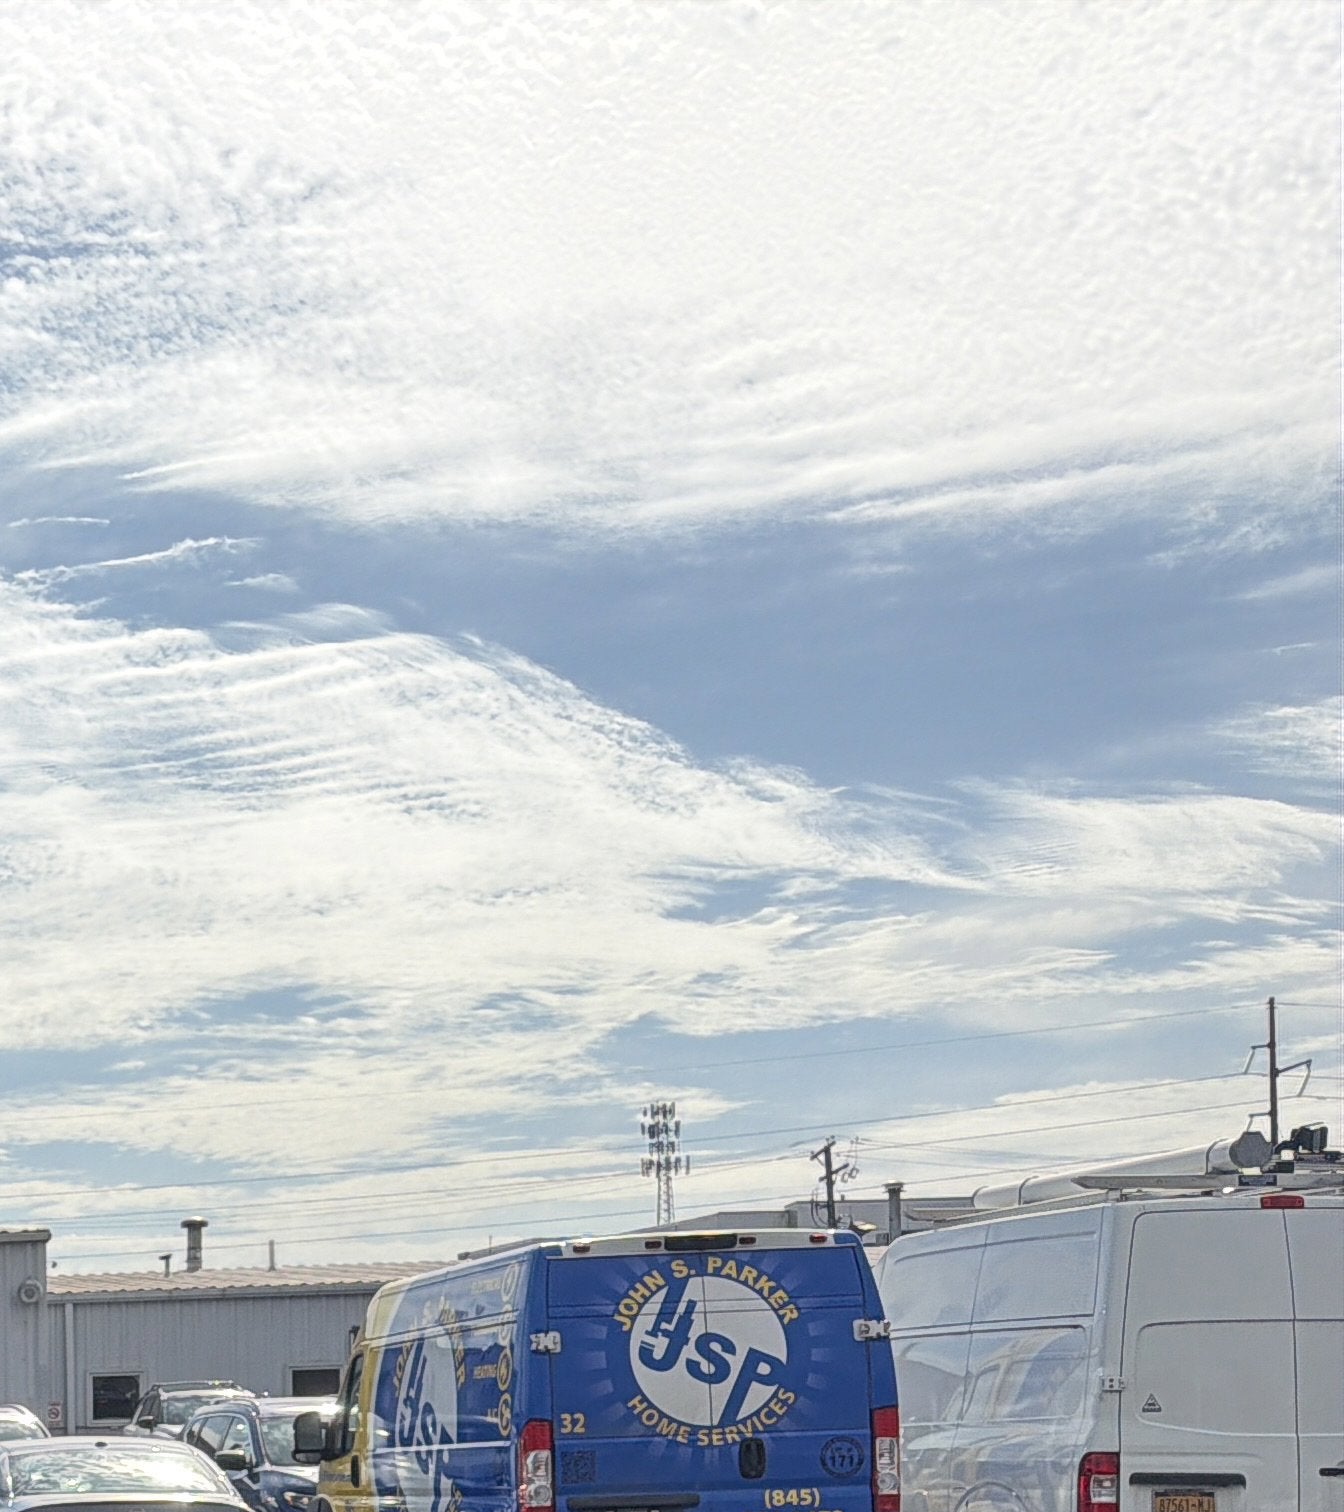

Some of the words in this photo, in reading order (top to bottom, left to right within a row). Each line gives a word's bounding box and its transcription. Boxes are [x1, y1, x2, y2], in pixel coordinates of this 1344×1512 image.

[613, 1269, 666, 1332] JOHN
[670, 1259, 697, 1279] S.
[707, 1256, 800, 1326] PARKER
[638, 1278, 788, 1427] JSP
[560, 1413, 586, 1434] 32
[627, 1394, 691, 1444] HOME
[697, 1386, 795, 1446] SERVICES
[764, 1488, 820, 1508] (845)
